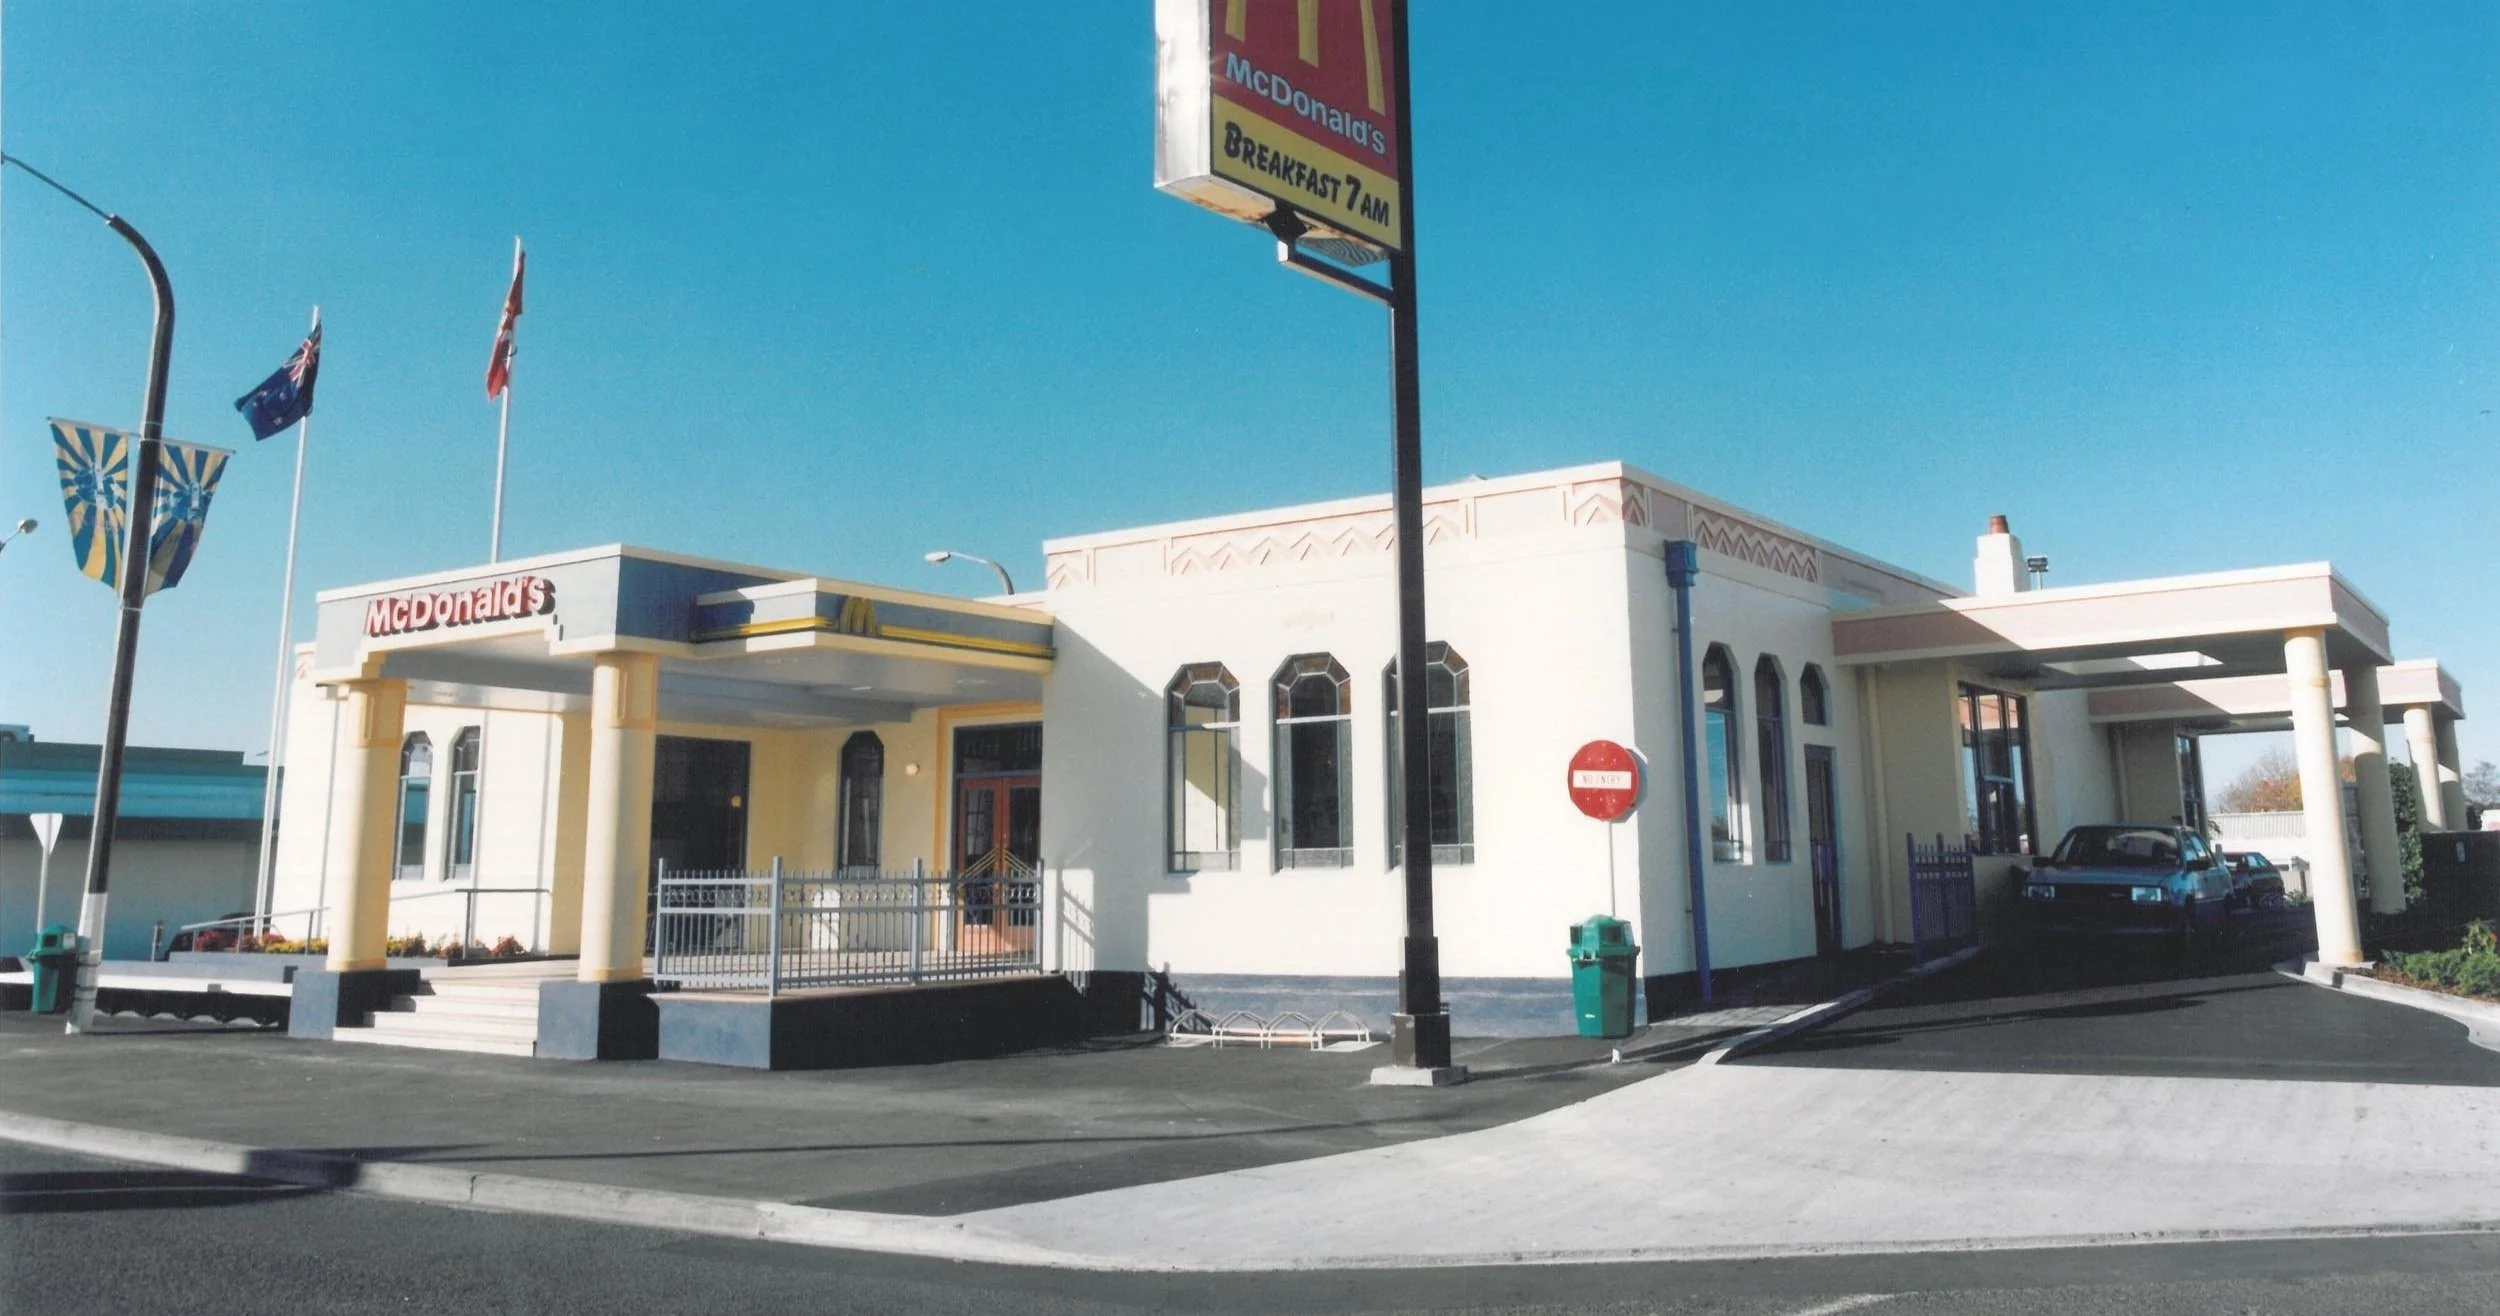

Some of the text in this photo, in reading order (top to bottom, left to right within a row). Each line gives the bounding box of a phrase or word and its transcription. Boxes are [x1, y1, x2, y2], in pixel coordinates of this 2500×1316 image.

[1226, 52, 1385, 155] McDonald's
[1225, 121, 1388, 227] BREAKFAST 7 AM
[365, 577, 552, 636] McDonald's
